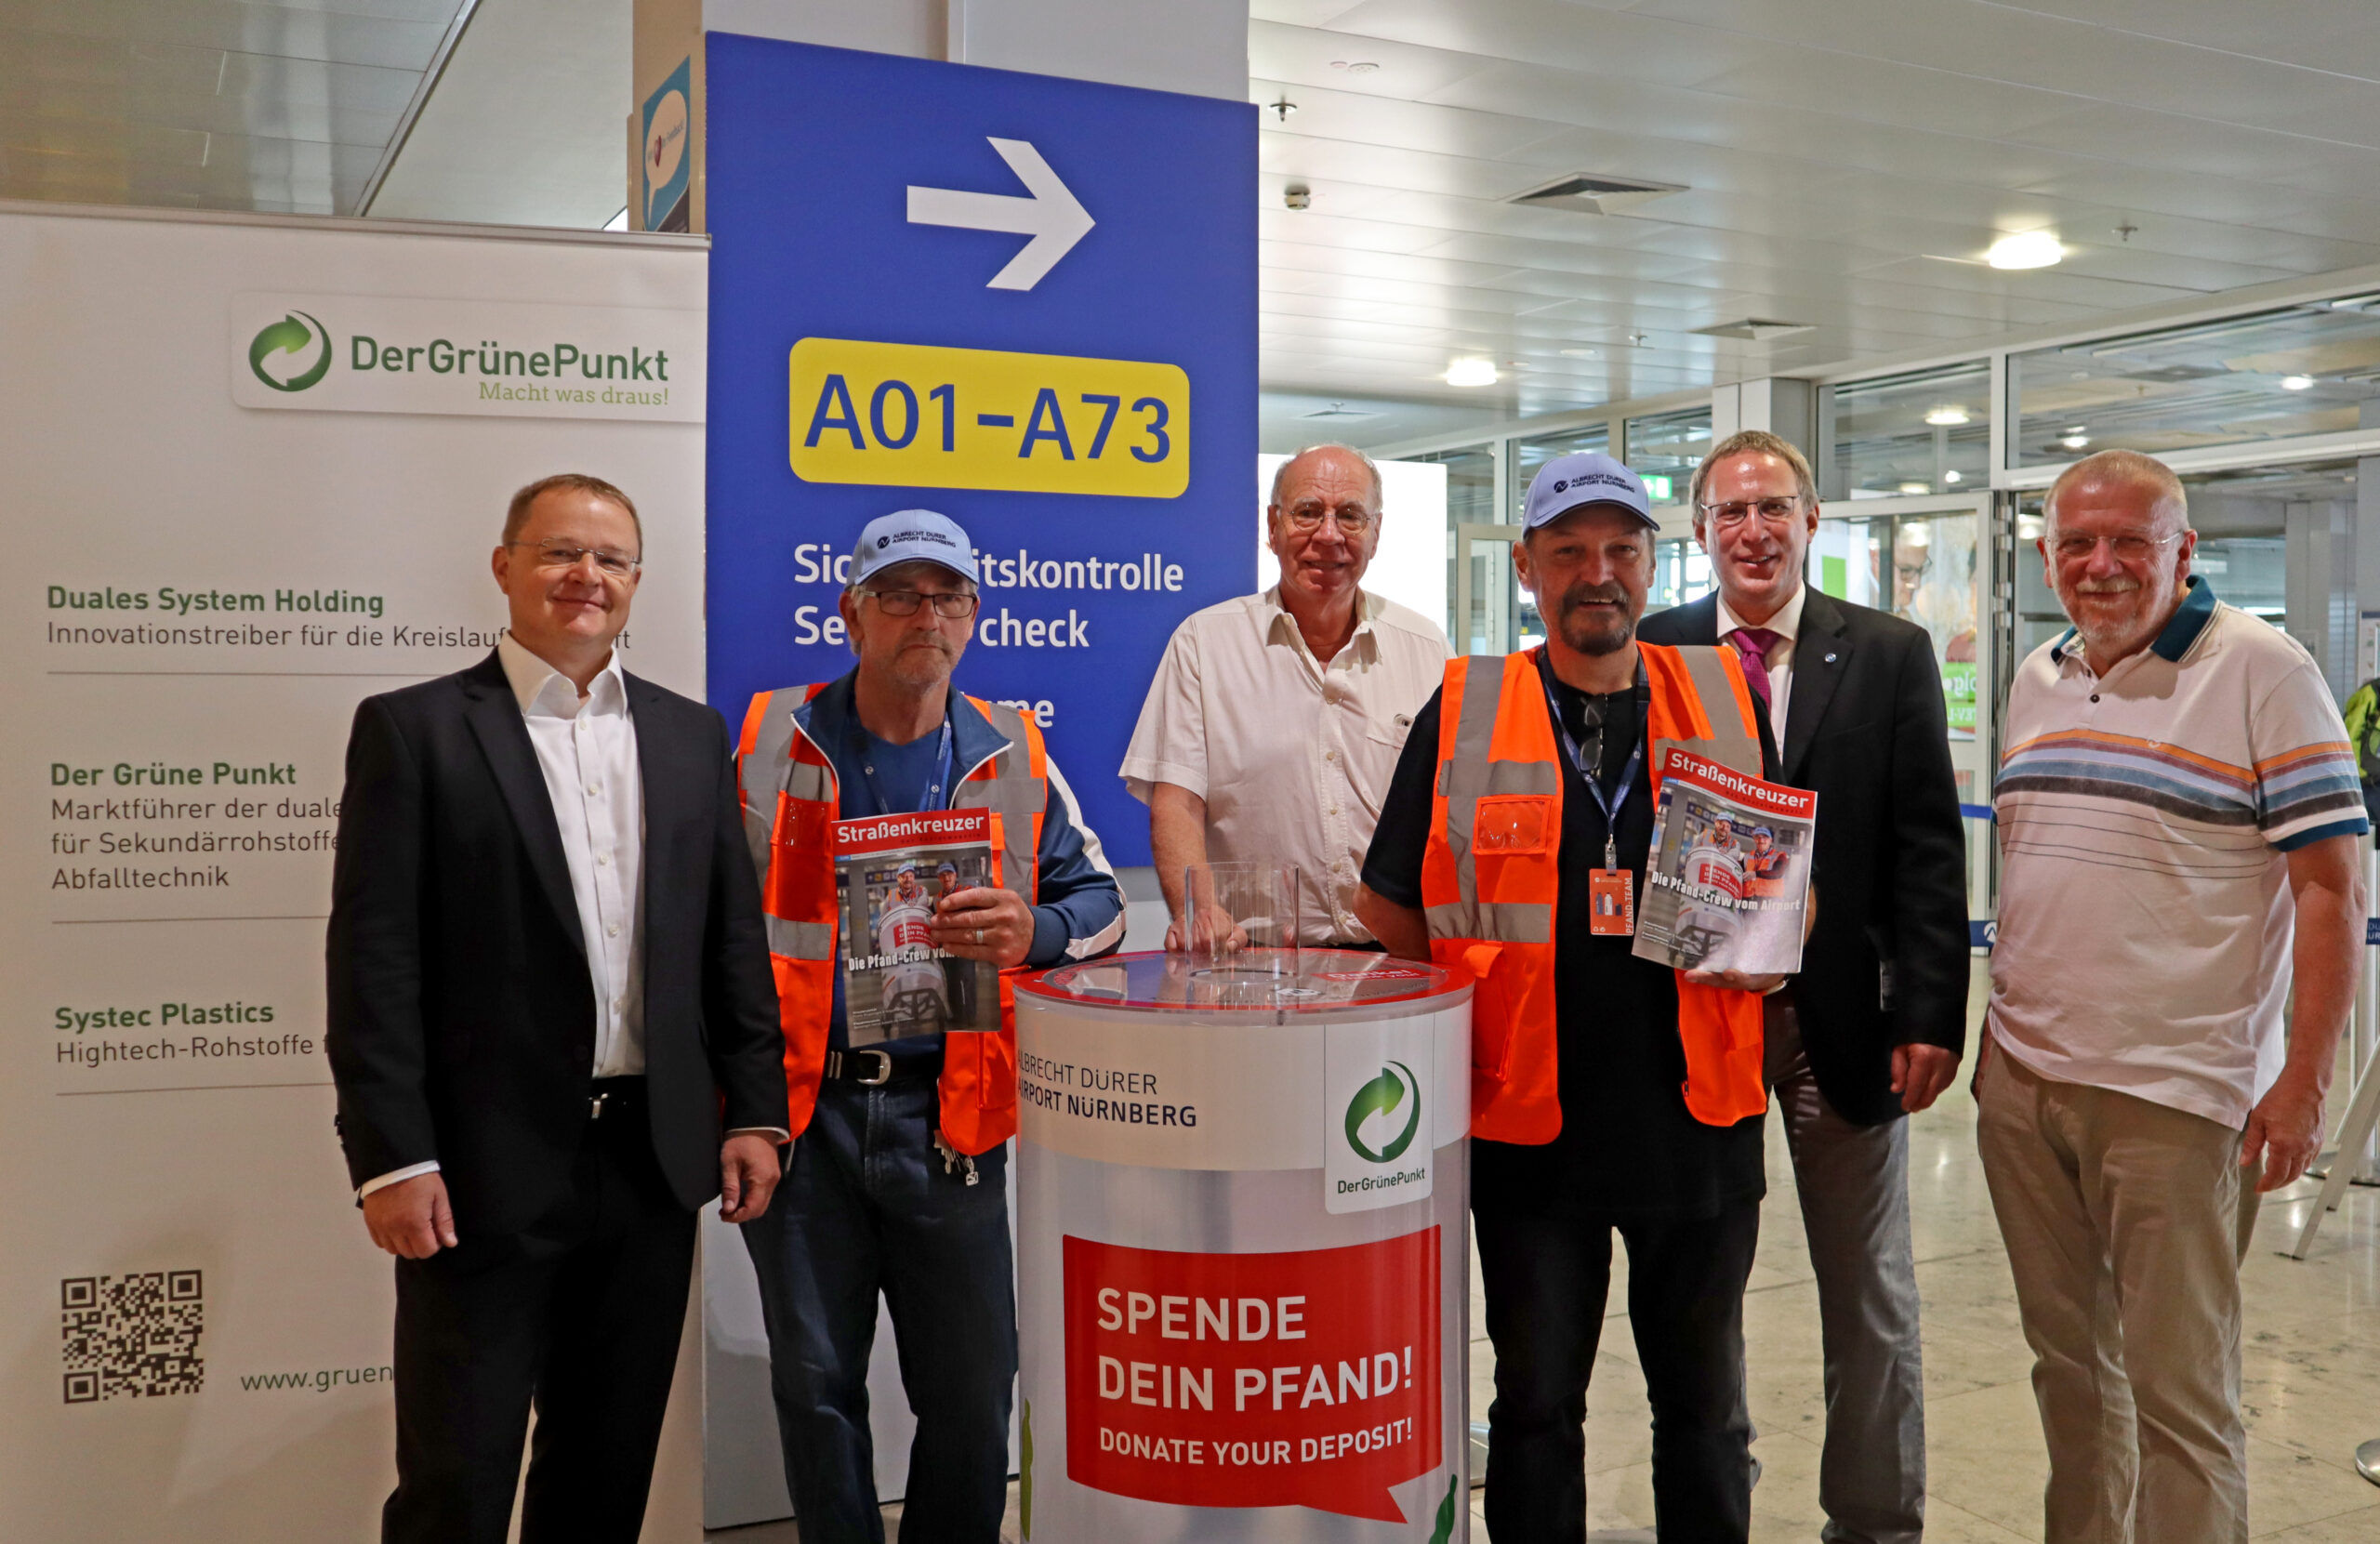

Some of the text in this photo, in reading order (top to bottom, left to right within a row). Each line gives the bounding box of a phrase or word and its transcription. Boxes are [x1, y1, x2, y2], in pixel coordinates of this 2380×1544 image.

[351, 336, 668, 381] DerGrünePunkt
[479, 381, 668, 405] Macht was draus!
[1570, 480, 1599, 488] AIRPORT
[1571, 474, 1605, 483] ALBRECHT
[892, 531, 924, 539] ALBRECHT
[47, 586, 383, 618] Duales System Holding
[47, 622, 292, 647] Innovationstreiber
[301, 624, 337, 647] für
[347, 625, 383, 648] die
[980, 607, 1090, 648] check
[51, 762, 297, 785] Der Grüne Punkt
[1670, 752, 1809, 809] Straßenkreuzer
[52, 798, 216, 820] Marktführer
[225, 798, 268, 819] der
[838, 816, 985, 843] Straßenkreuzer
[52, 833, 91, 854] für
[52, 865, 230, 890] Abfalltechnik
[1651, 871, 1801, 912] Die Pfand-Crew vom Airport
[848, 957, 866, 971] Die
[867, 950, 931, 969] Pfand-Crew
[55, 1001, 274, 1034] Systec Plastics
[58, 1034, 314, 1068] Hightech-Rohstoffe
[1081, 1068, 1157, 1095] DÜRER
[1067, 1094, 1197, 1127] NÜRNBERG
[1337, 1168, 1425, 1194] DerGrünePunkt
[1098, 1287, 1306, 1341] SPENDE
[1099, 1346, 1412, 1411] DEIN PFAND!
[1100, 1417, 1412, 1465] DONATE YOUR DEPOSIT!
